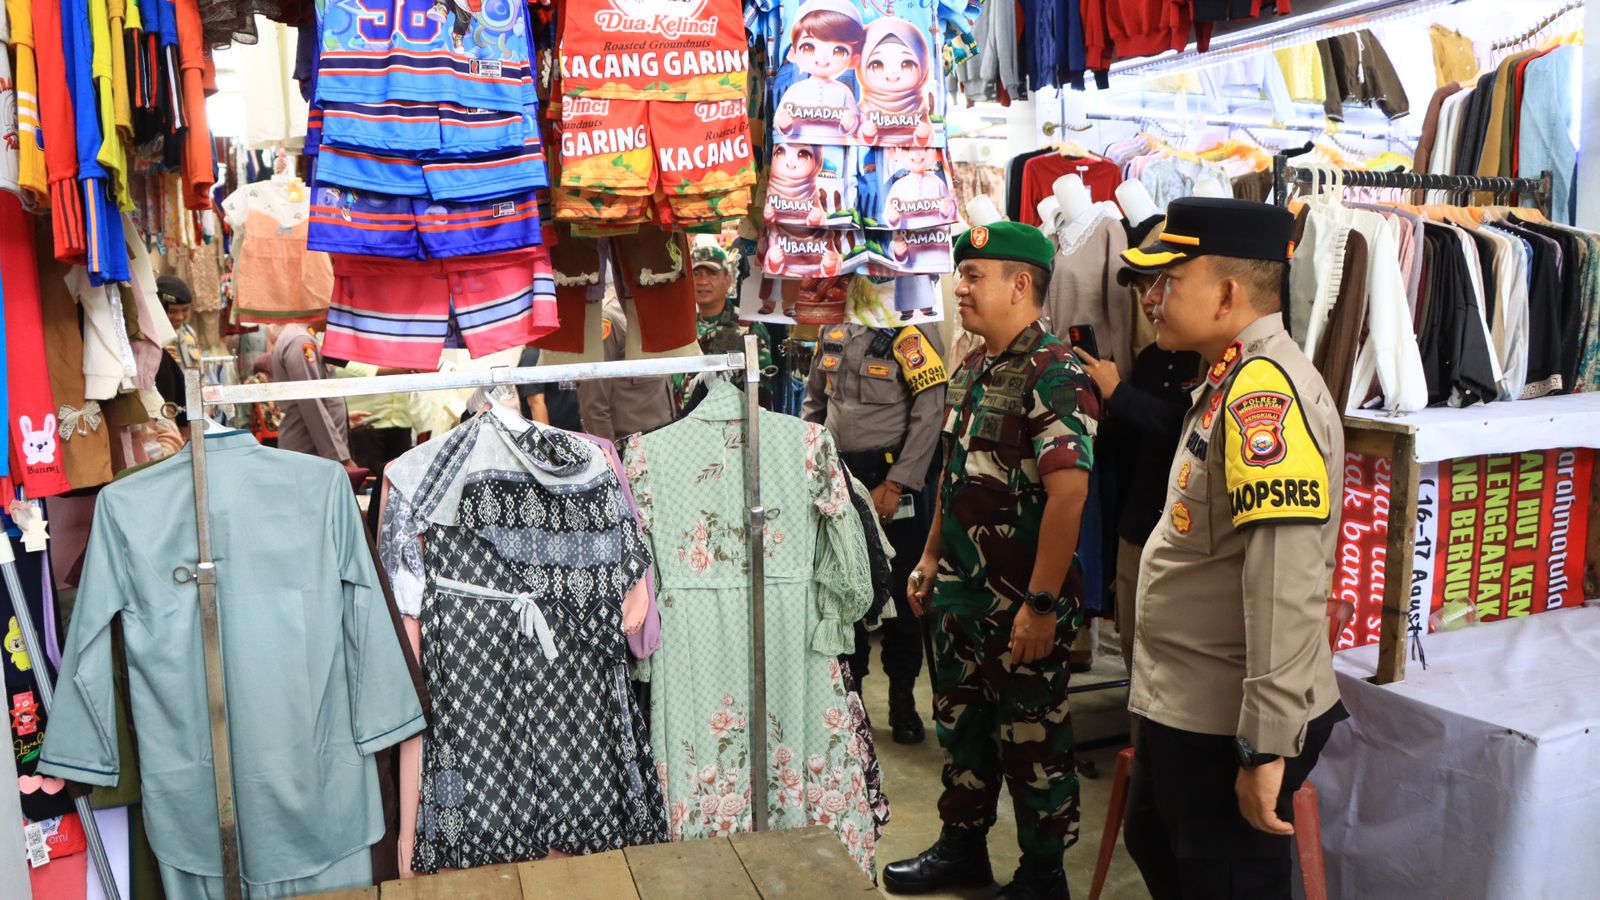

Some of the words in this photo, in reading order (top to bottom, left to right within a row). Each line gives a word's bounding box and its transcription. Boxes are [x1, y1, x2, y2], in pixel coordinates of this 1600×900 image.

[594, 10, 648, 32] Dua
[649, 14, 718, 40] Kelinci
[603, 41, 646, 51] Roasted
[649, 39, 711, 50] Groundnuts
[784, 102, 848, 120] RAMADAN
[869, 111, 923, 127] MUBARAK
[561, 124, 648, 157] GARING
[660, 134, 749, 172] KACANG
[769, 195, 815, 211] MUBARAK
[777, 236, 828, 254] MUBARAK
[1242, 396, 1278, 408] POLRES
[1451, 458, 1479, 503] NG
[1518, 452, 1544, 492] AN
[1476, 453, 1512, 618] LENGGARAK
[1512, 497, 1540, 549] HUT
[1338, 521, 1371, 648] bana
